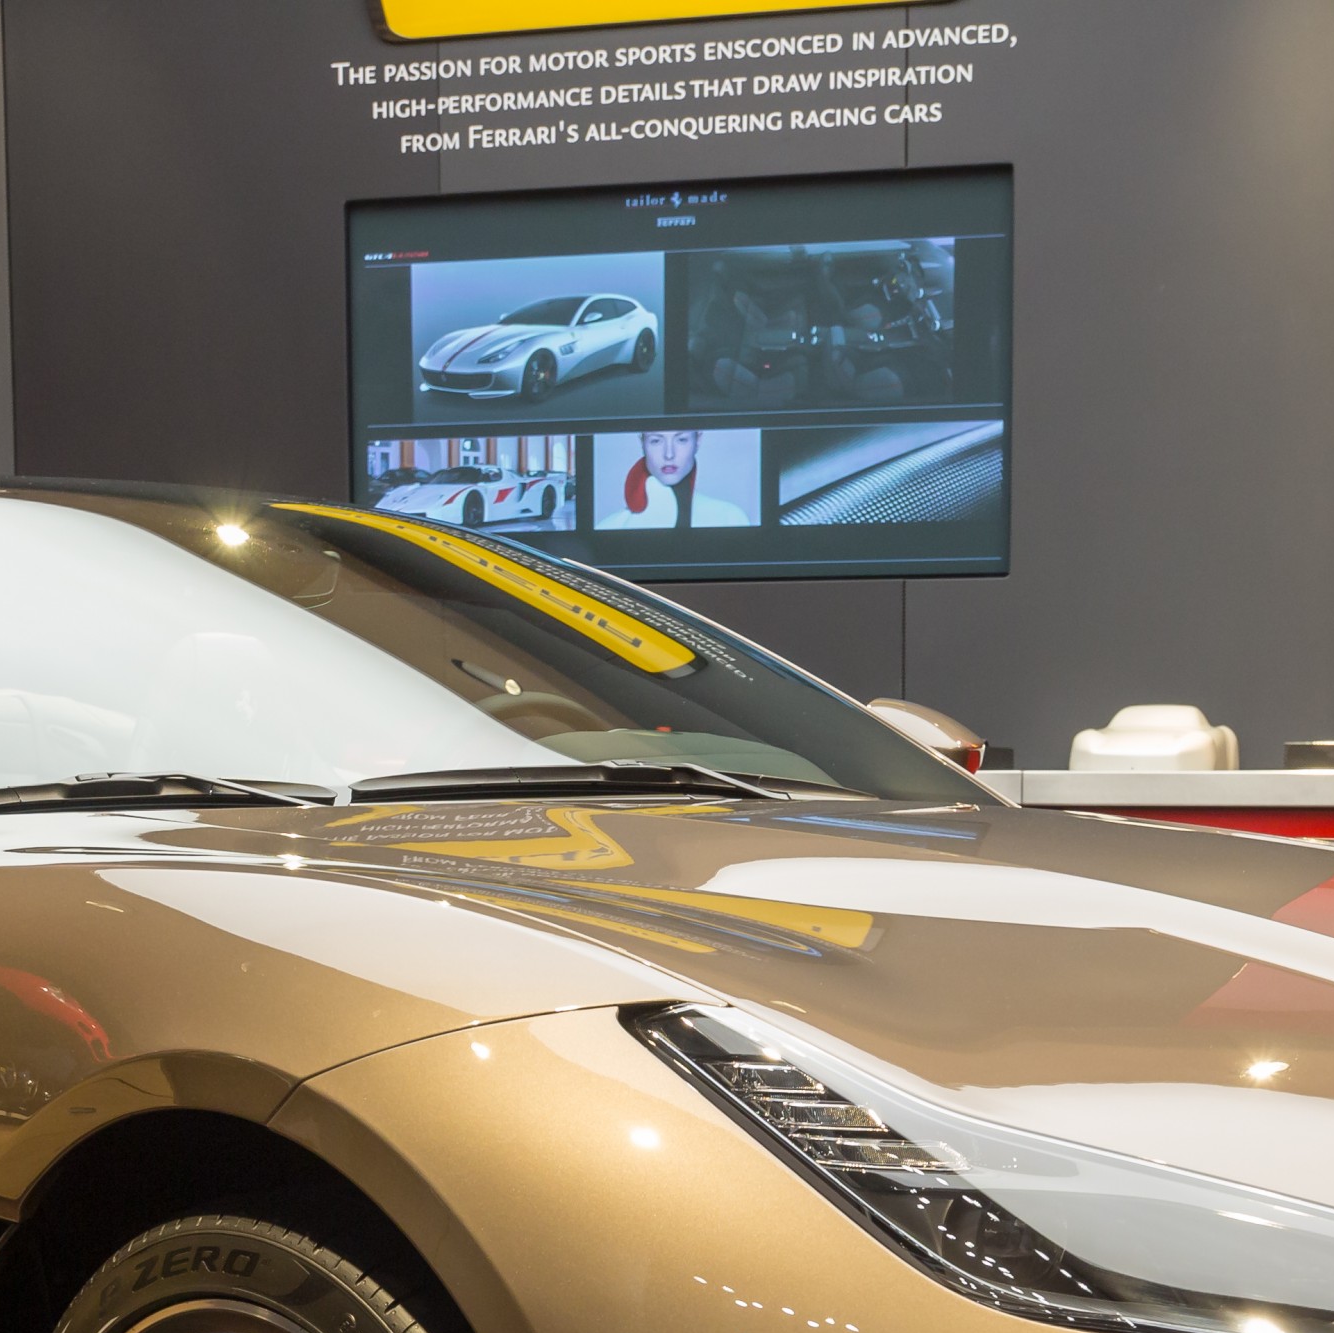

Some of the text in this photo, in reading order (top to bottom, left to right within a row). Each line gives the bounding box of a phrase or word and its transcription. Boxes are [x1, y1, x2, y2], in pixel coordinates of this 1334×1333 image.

[384, 59, 472, 83] PASSION
[479, 56, 522, 76] FOR
[529, 49, 609, 73] MOTOR
[615, 44, 696, 66] SPORTS
[703, 33, 843, 61] ENSCONCED
[852, 32, 875, 50] IN
[882, 23, 1018, 49] ADVANCED,
[372, 63, 973, 119] HIGH-PERFORMANCE DETAILS THAT DRAW INSPIRATION
[400, 132, 460, 153] FROM
[585, 111, 782, 140] ALL-CONQUERING
[791, 106, 877, 130] RACING
[883, 103, 942, 124] CARS
[625, 191, 728, 207] tailor made
[131, 1245, 261, 1293] ZERO
